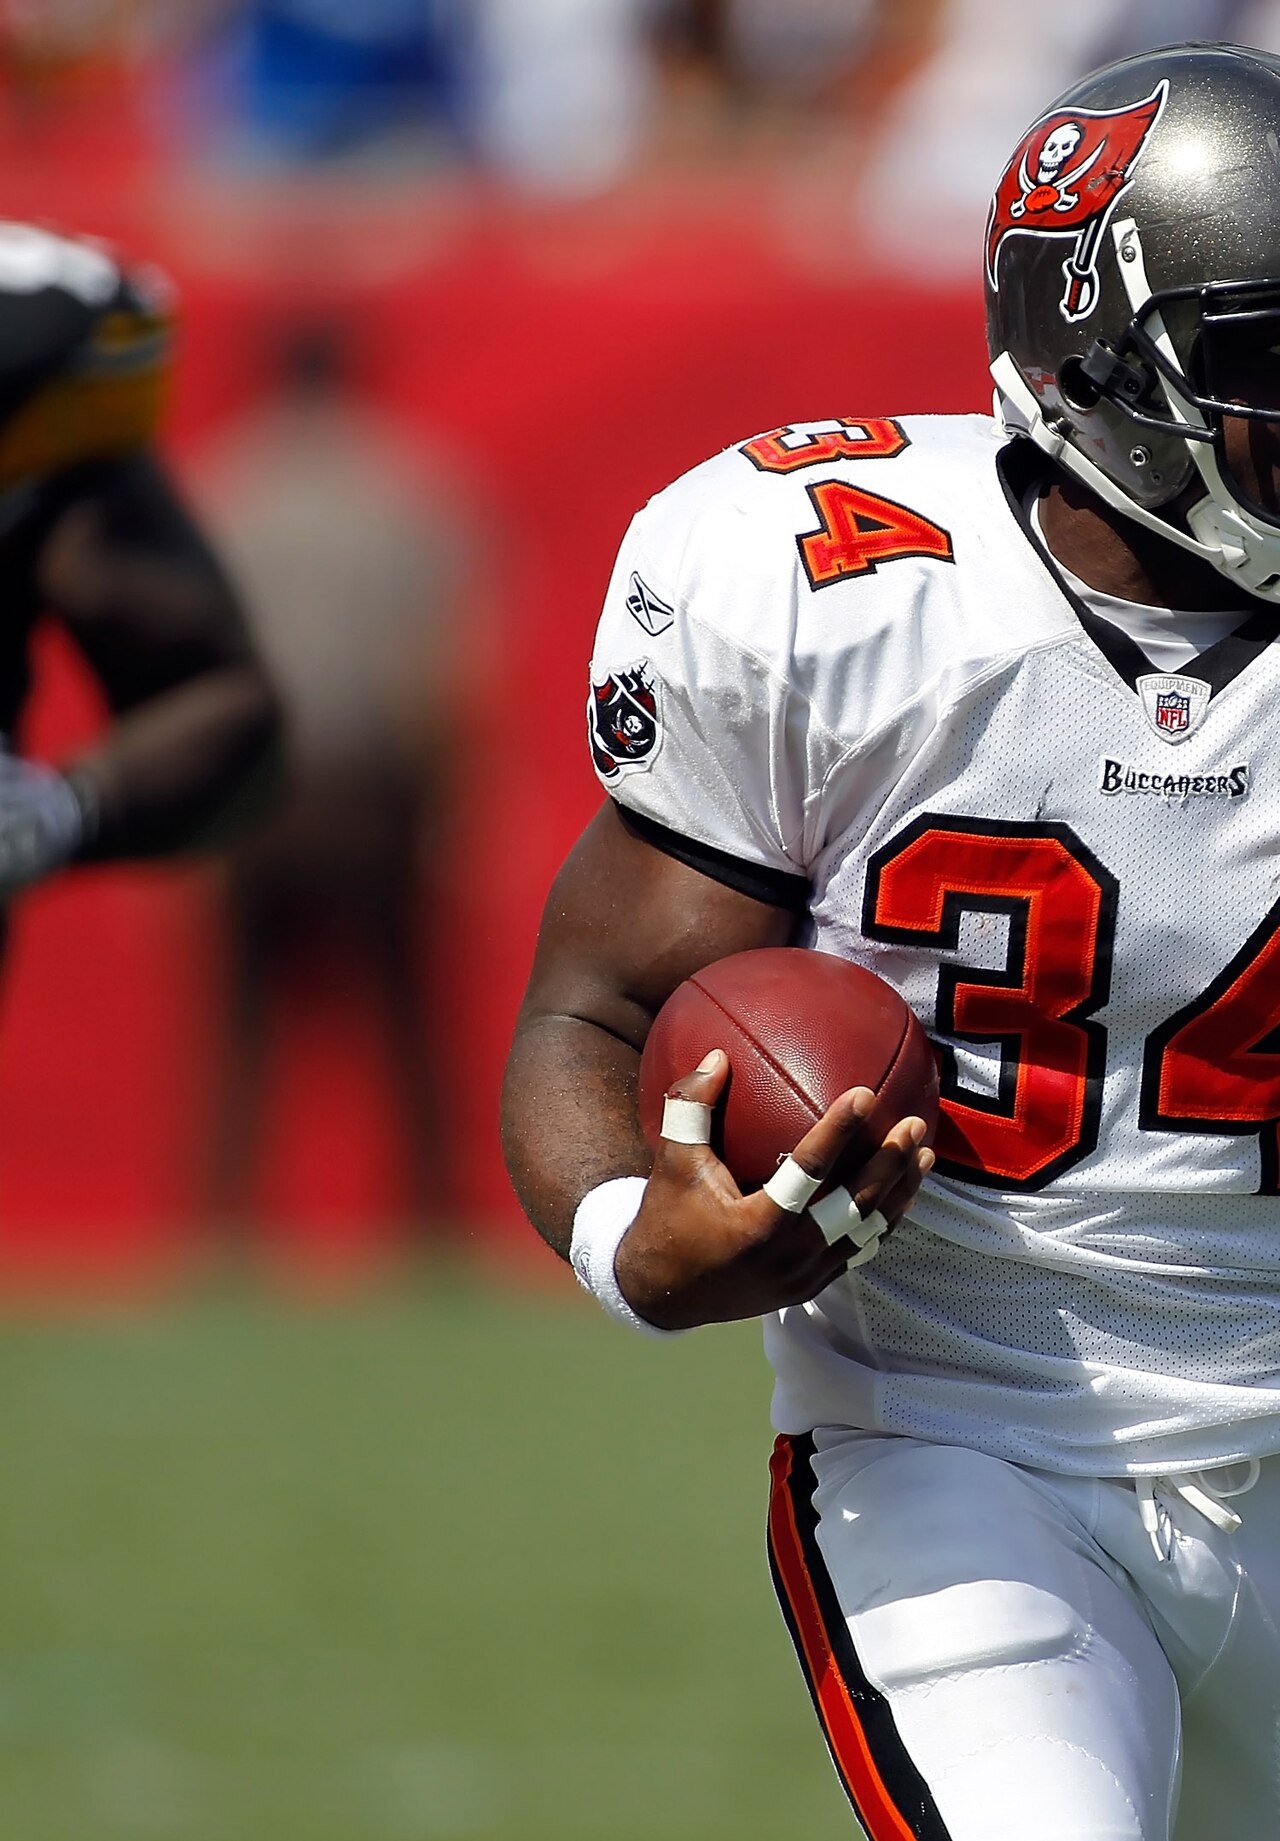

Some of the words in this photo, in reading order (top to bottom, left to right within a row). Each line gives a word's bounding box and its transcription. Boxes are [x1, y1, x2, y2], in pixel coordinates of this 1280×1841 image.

[738, 416, 956, 592] 34
[1144, 679, 1205, 697] EQUIPMENT
[1158, 707, 1187, 729] NFL
